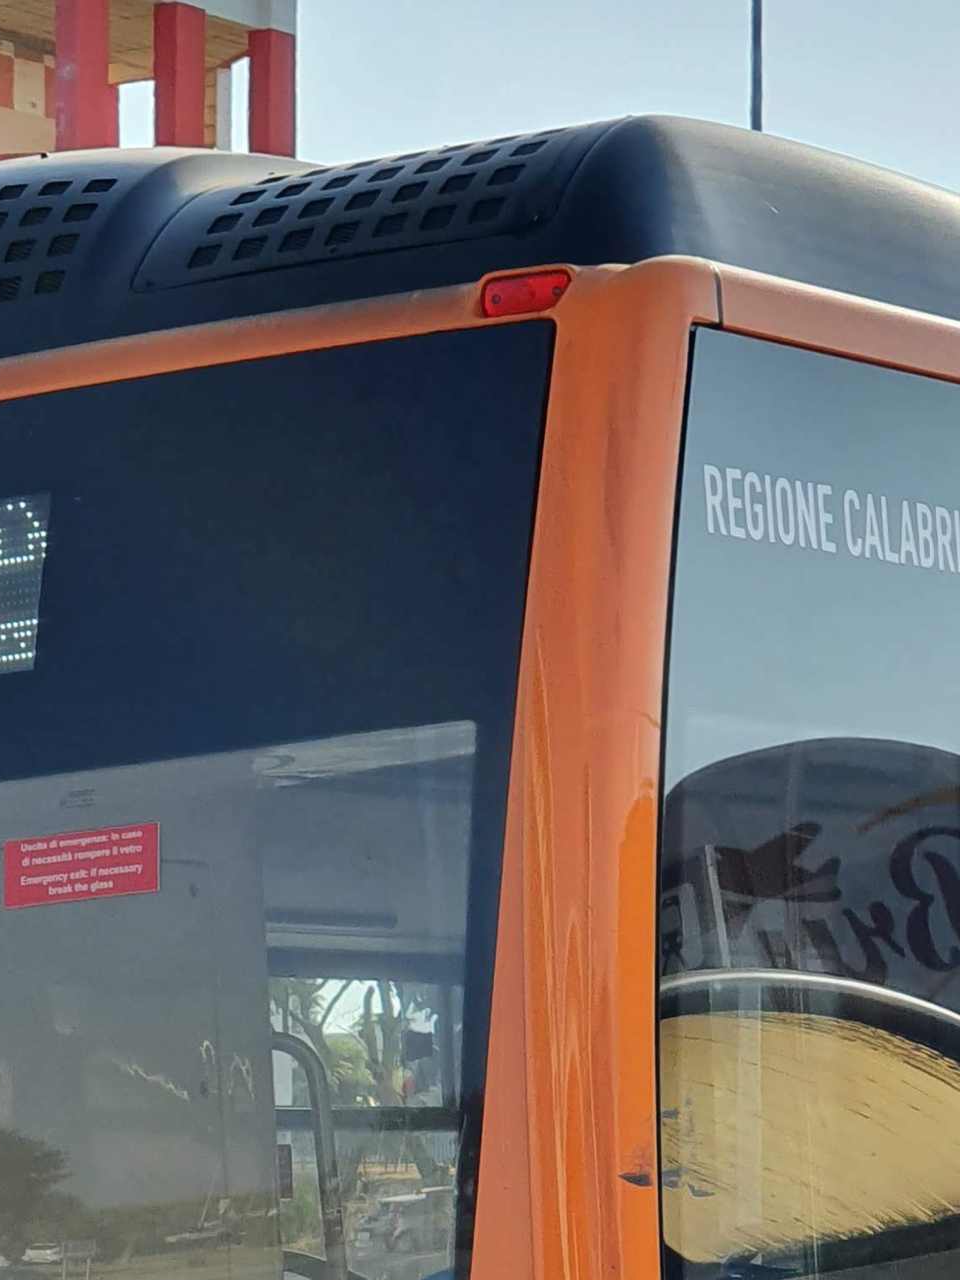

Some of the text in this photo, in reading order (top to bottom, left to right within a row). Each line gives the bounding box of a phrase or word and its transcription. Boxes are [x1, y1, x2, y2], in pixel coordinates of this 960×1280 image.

[703, 464, 838, 554] REGIONE
[20, 842, 48, 852] Uscita
[49, 840, 58, 848] di
[121, 831, 143, 840] caso
[22, 856, 30, 866] di
[74, 849, 111, 860] rompere
[120, 845, 143, 855] vetro
[20, 873, 68, 886] Emergency
[90, 867, 97, 877] if
[98, 864, 143, 877] necessary
[48, 880, 114, 895] break the glass
